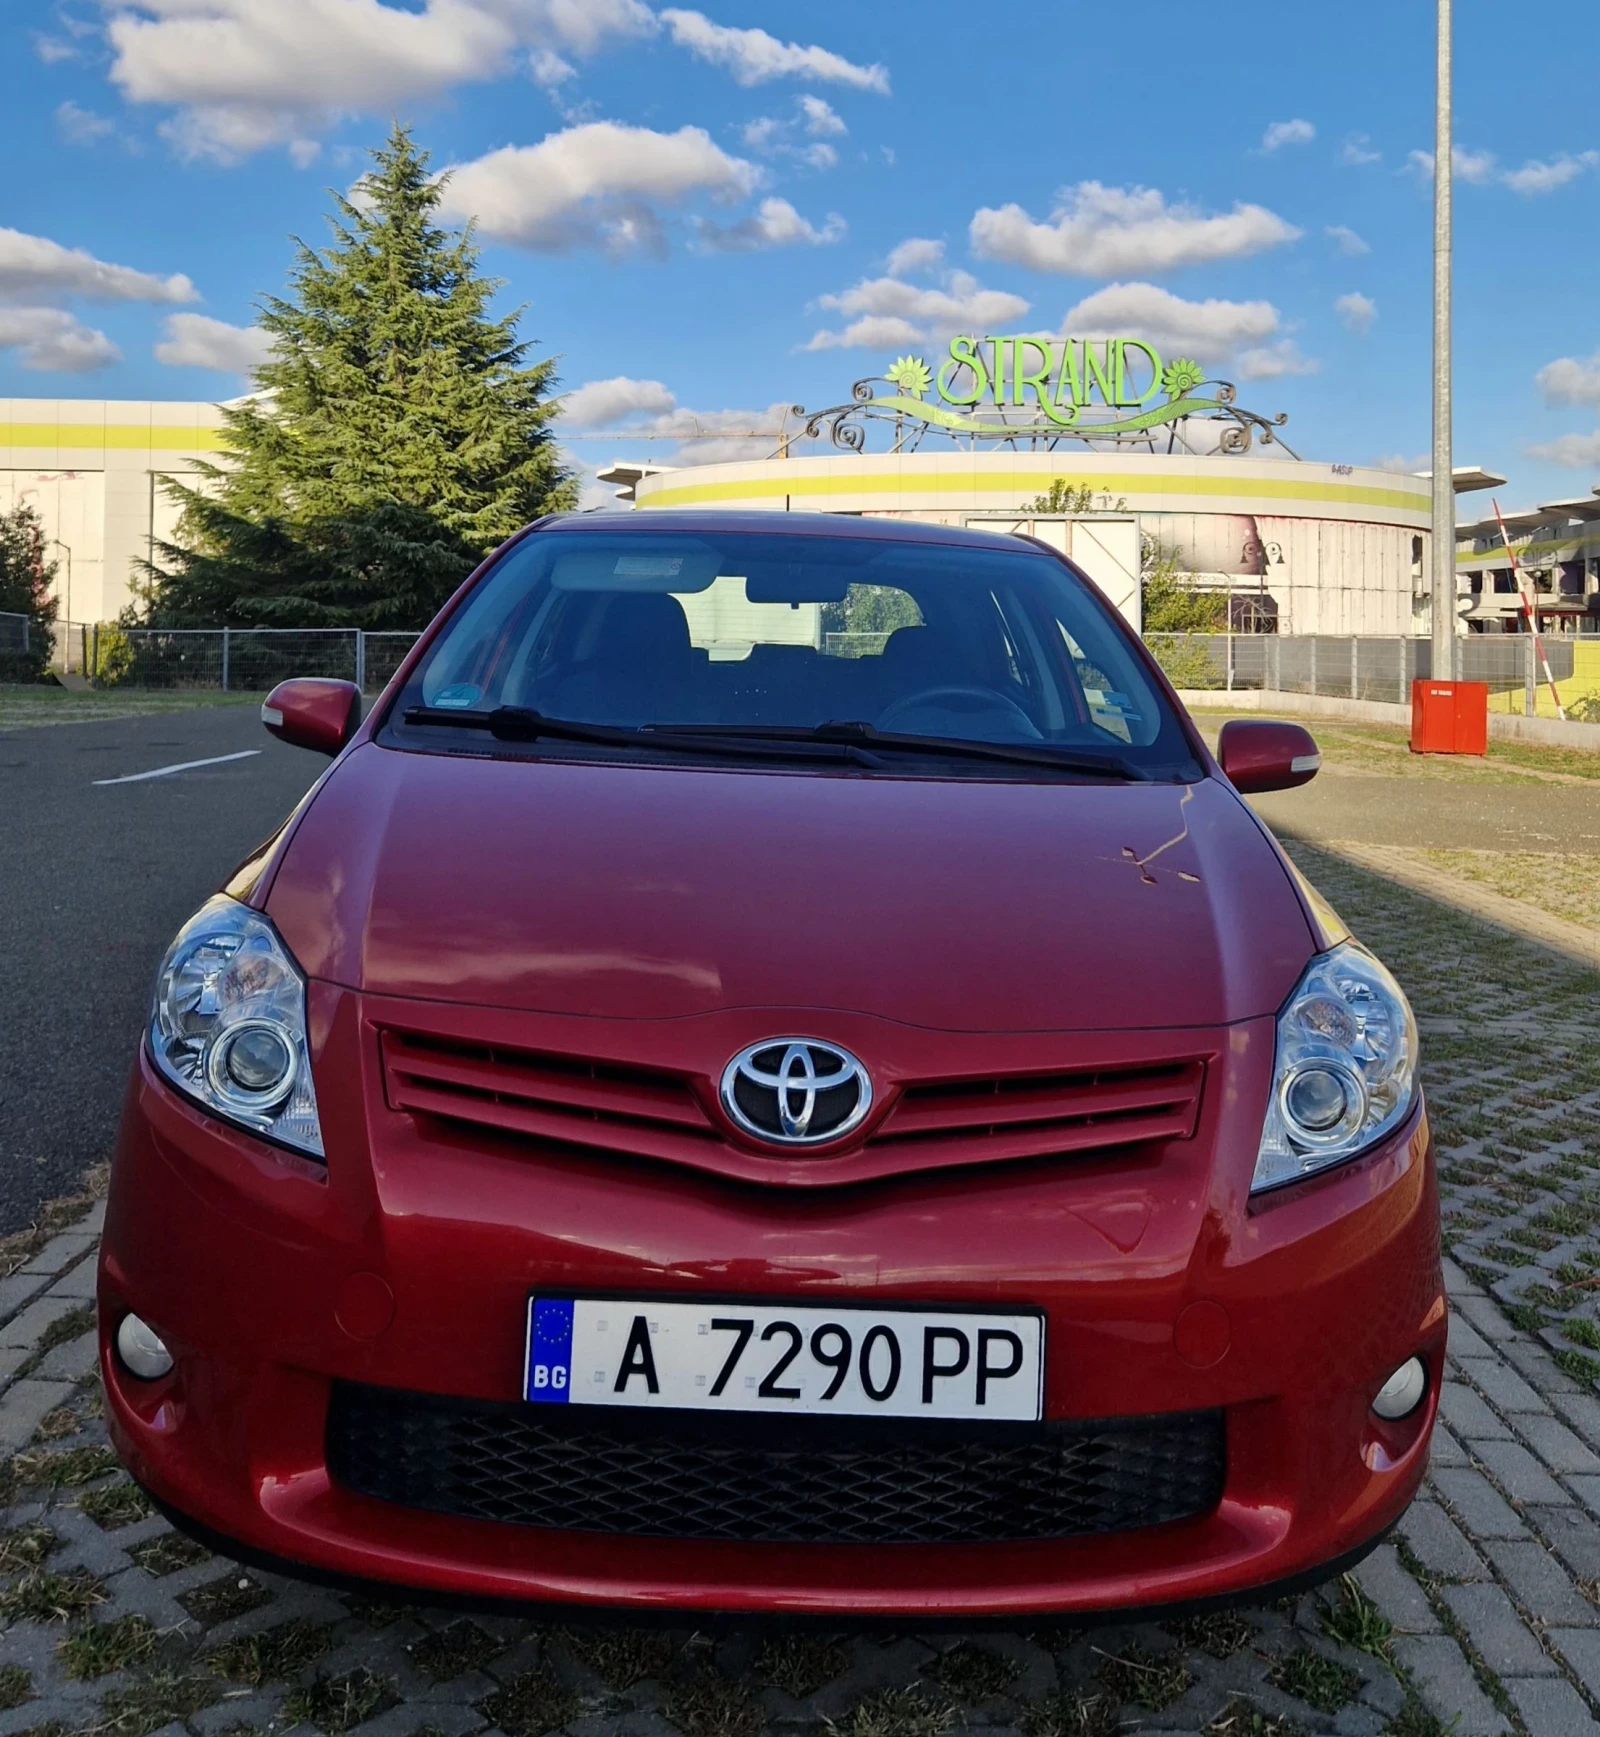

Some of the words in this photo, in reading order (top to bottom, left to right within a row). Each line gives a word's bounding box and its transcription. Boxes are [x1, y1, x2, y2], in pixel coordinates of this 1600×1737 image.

[937, 335, 1163, 425] STRAND
[533, 1364, 567, 1389] BG
[613, 1315, 660, 1394] A
[708, 1318, 902, 1402] 7290
[921, 1326, 1024, 1406] PP
